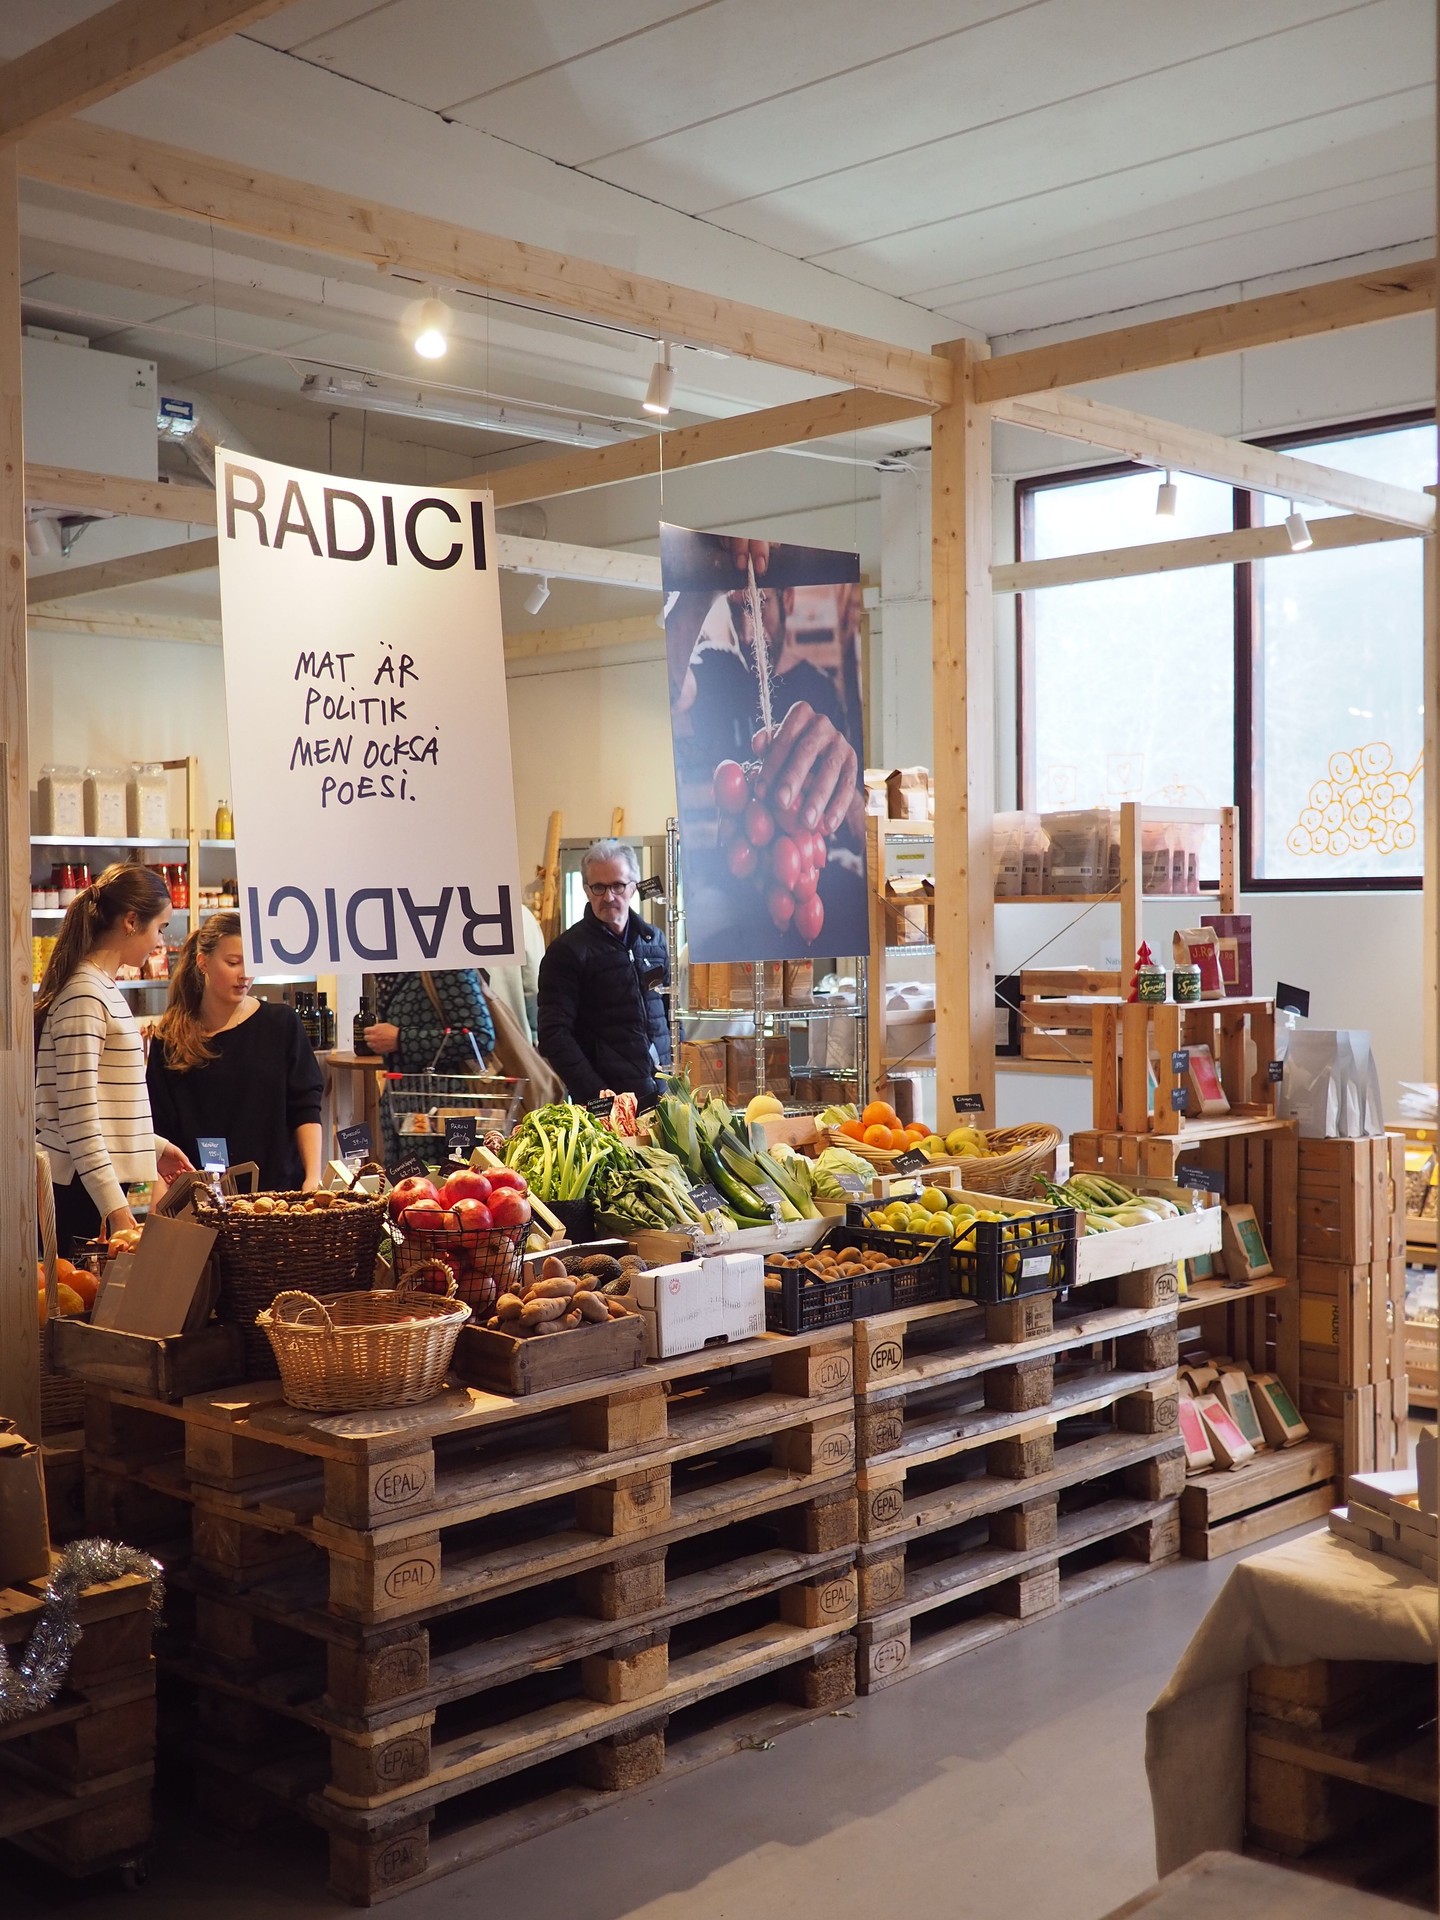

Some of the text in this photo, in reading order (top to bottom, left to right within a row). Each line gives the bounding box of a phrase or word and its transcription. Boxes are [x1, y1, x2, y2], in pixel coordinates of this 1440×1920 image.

[223, 461, 488, 571] RADICI
[293, 640, 420, 689] MAT ÄR
[289, 734, 354, 771] MEN
[247, 884, 516, 966] RADICI
[1158, 1278, 1176, 1296] EPAL
[875, 1345, 898, 1370] EPAL
[820, 1360, 846, 1384] EPAL
[1158, 1403, 1178, 1422] EPAL
[822, 1438, 846, 1461] EPAL
[383, 1470, 420, 1499] EPAL
[876, 1494, 900, 1518] EPAL
[393, 1566, 428, 1591] EPAL
[824, 1584, 851, 1609] EPAL
[383, 1747, 417, 1776] EPAL
